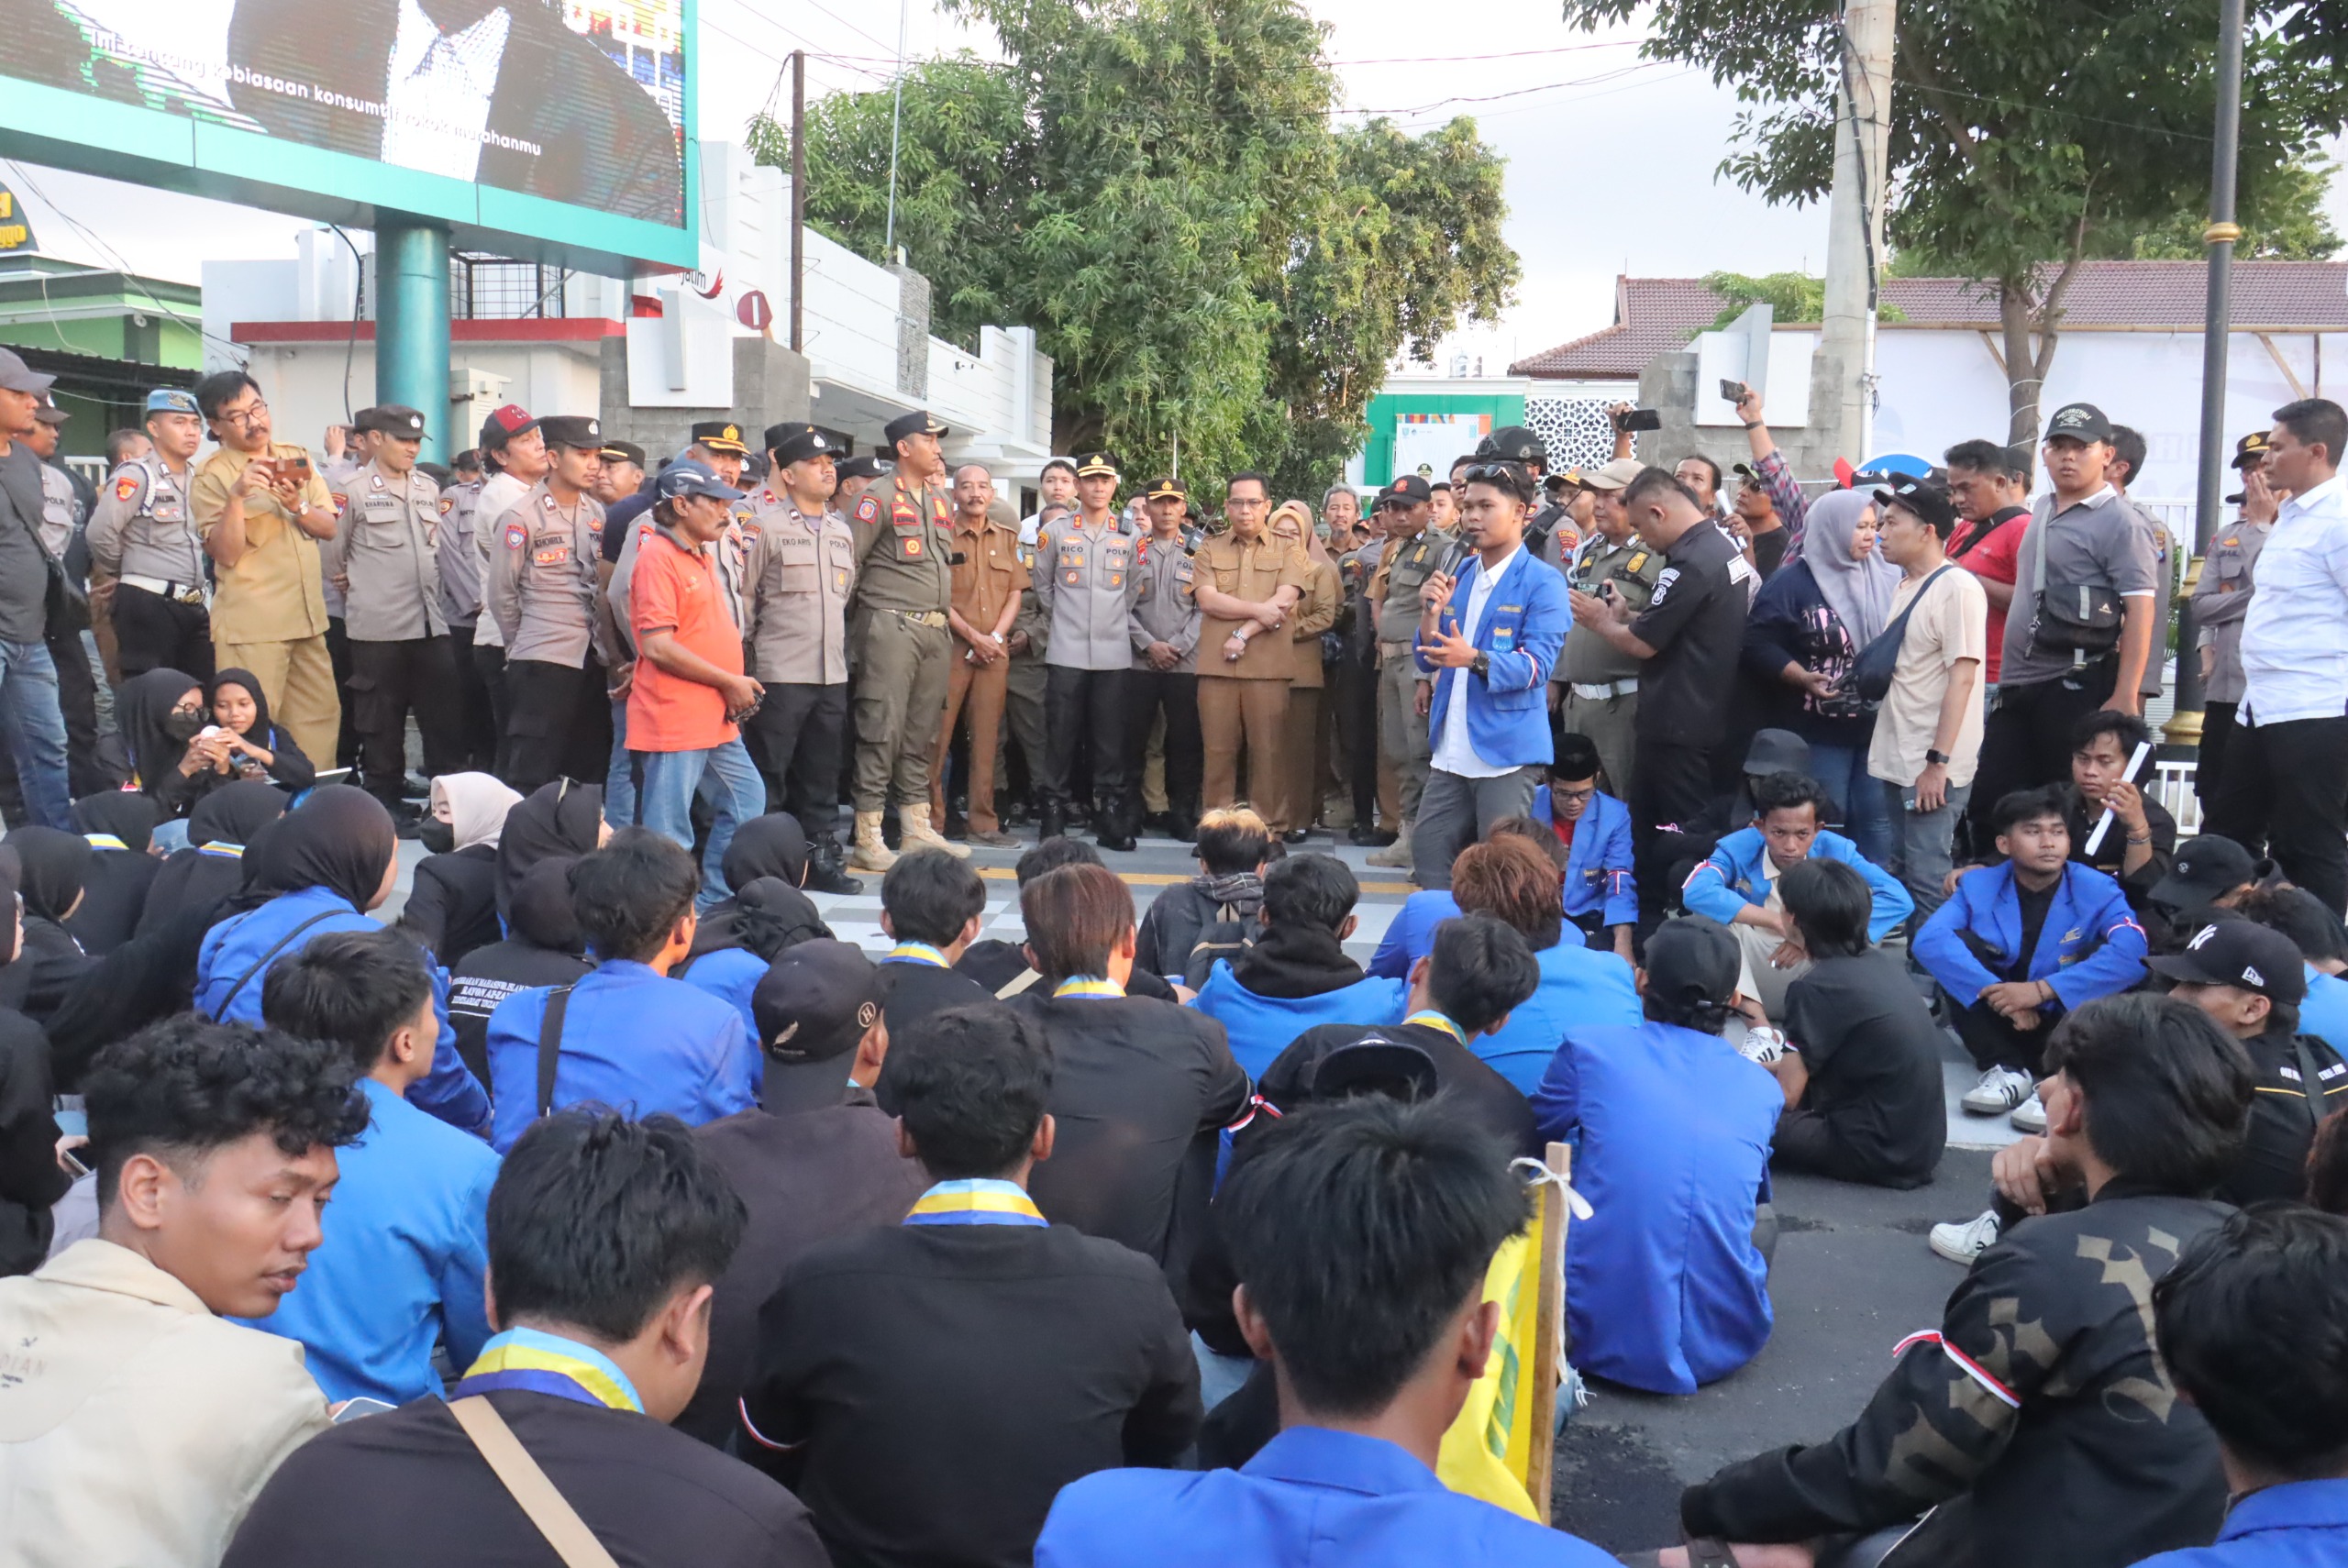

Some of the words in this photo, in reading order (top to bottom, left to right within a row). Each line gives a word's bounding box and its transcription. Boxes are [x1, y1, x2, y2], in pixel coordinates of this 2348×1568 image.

[214, 59, 308, 97] kebiasaan
[315, 84, 399, 122] konsumtif
[405, 111, 449, 135] rokok
[455, 127, 542, 156] murahanmu
[781, 538, 796, 547] EKO
[797, 538, 812, 547] ARIS
[829, 539, 848, 550] POLRI
[1060, 545, 1084, 554] RICO
[1106, 548, 1130, 558] POLRI
[460, 986, 486, 999] RAYON
